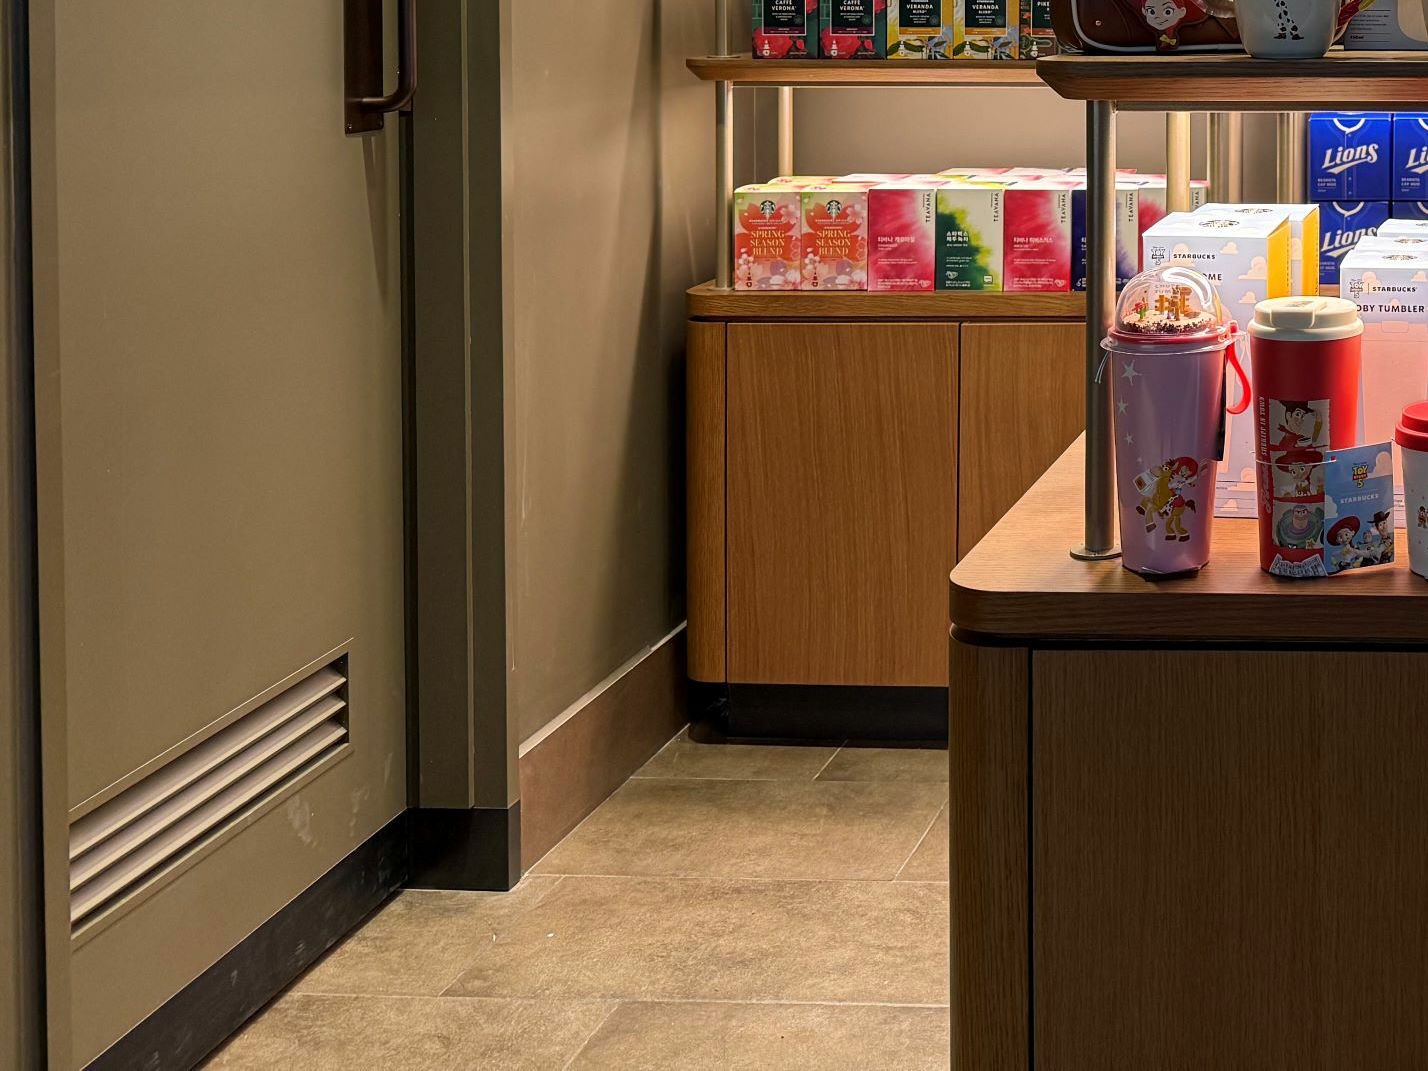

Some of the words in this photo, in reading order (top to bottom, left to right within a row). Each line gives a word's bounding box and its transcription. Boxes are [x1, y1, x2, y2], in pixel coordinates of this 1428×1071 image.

[1321, 143, 1379, 172] Lions
[750, 230, 785, 238] SPRING
[816, 230, 851, 238] SPRING
[750, 238, 786, 247] SEASON
[815, 238, 851, 247] SEASON
[753, 247, 784, 256] BLEND
[818, 247, 849, 256] BLEND
[1378, 304, 1425, 313] TUMBLER
[1352, 465, 1368, 475] TOY
[1356, 479, 1364, 488] 5
[1340, 493, 1379, 504] STARBUCKS
